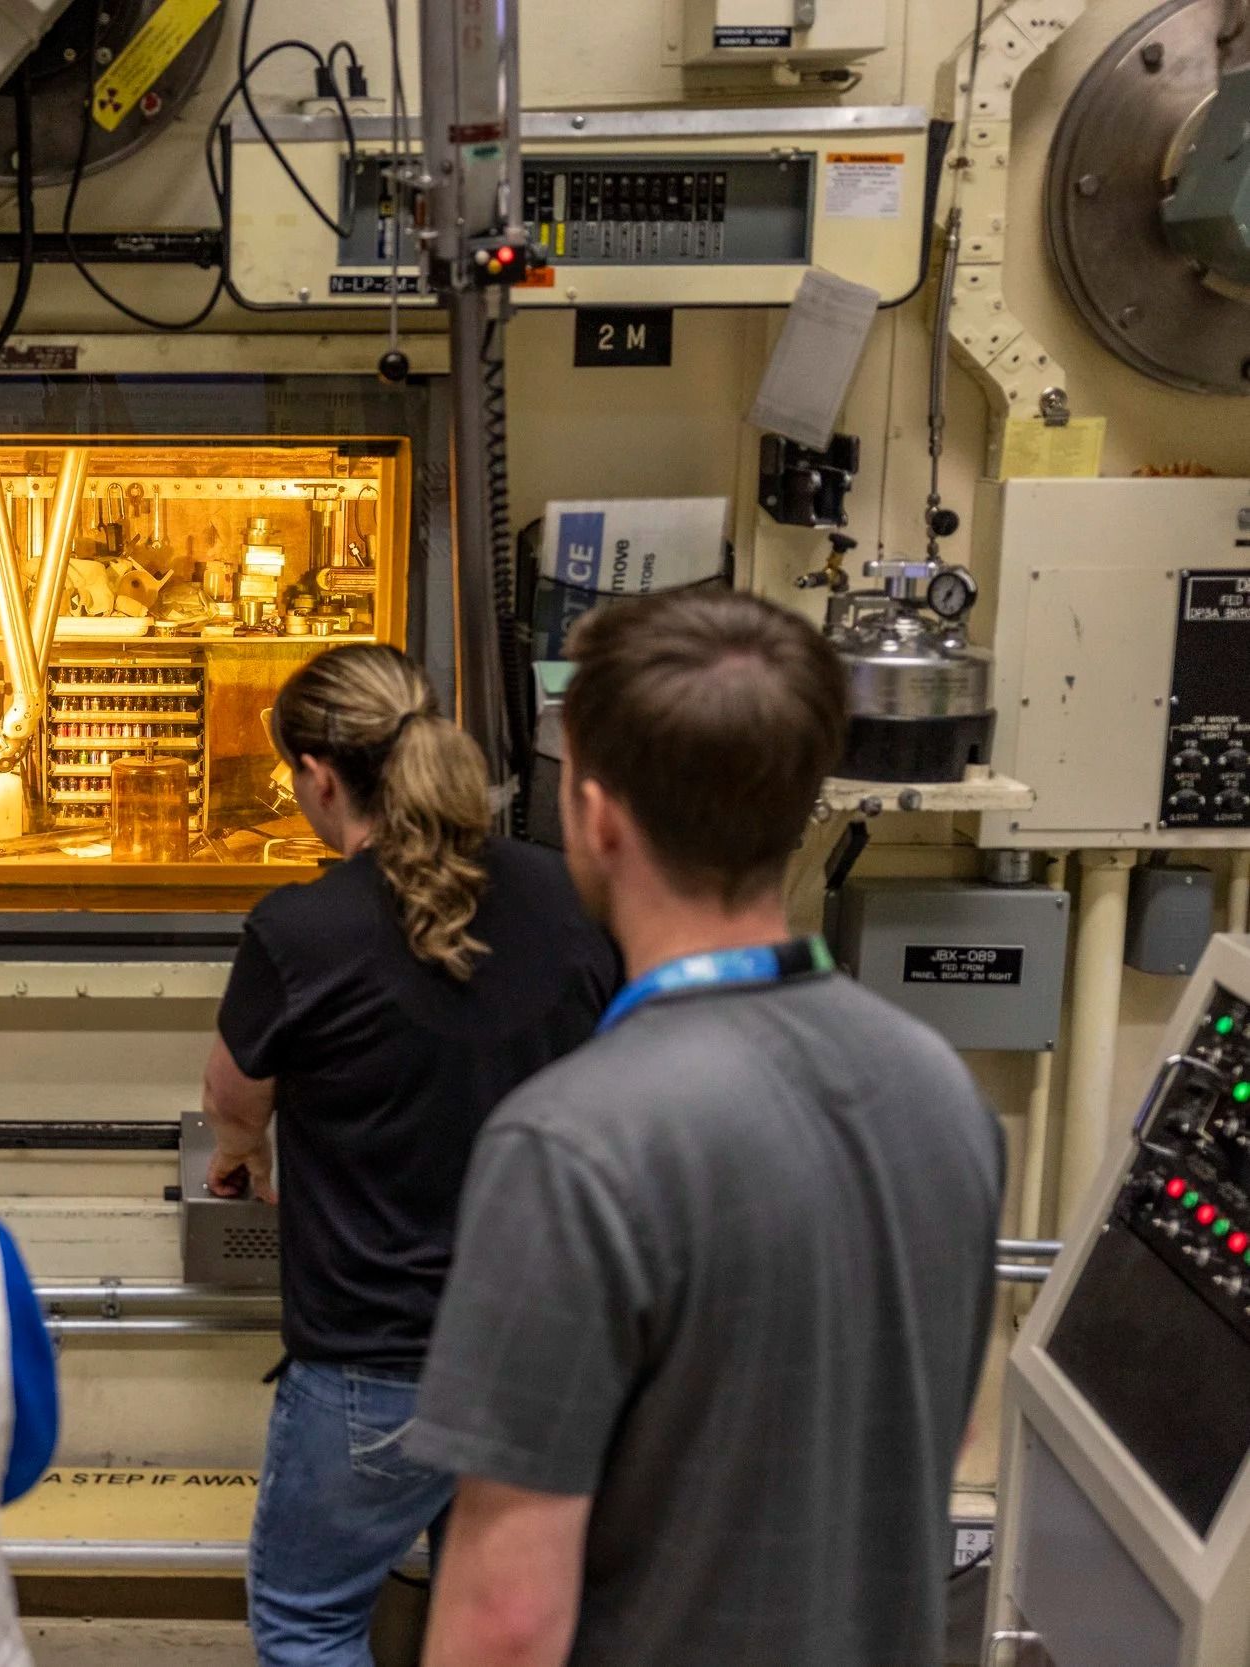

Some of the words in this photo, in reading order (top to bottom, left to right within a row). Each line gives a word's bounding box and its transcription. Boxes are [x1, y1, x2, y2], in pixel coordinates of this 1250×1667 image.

[598, 323, 615, 351] 2
[626, 323, 646, 351] M
[42, 1472, 62, 1484] A
[71, 1473, 145, 1485] STEP
[151, 1473, 177, 1485] IF
[182, 1474, 260, 1486] AWAY
